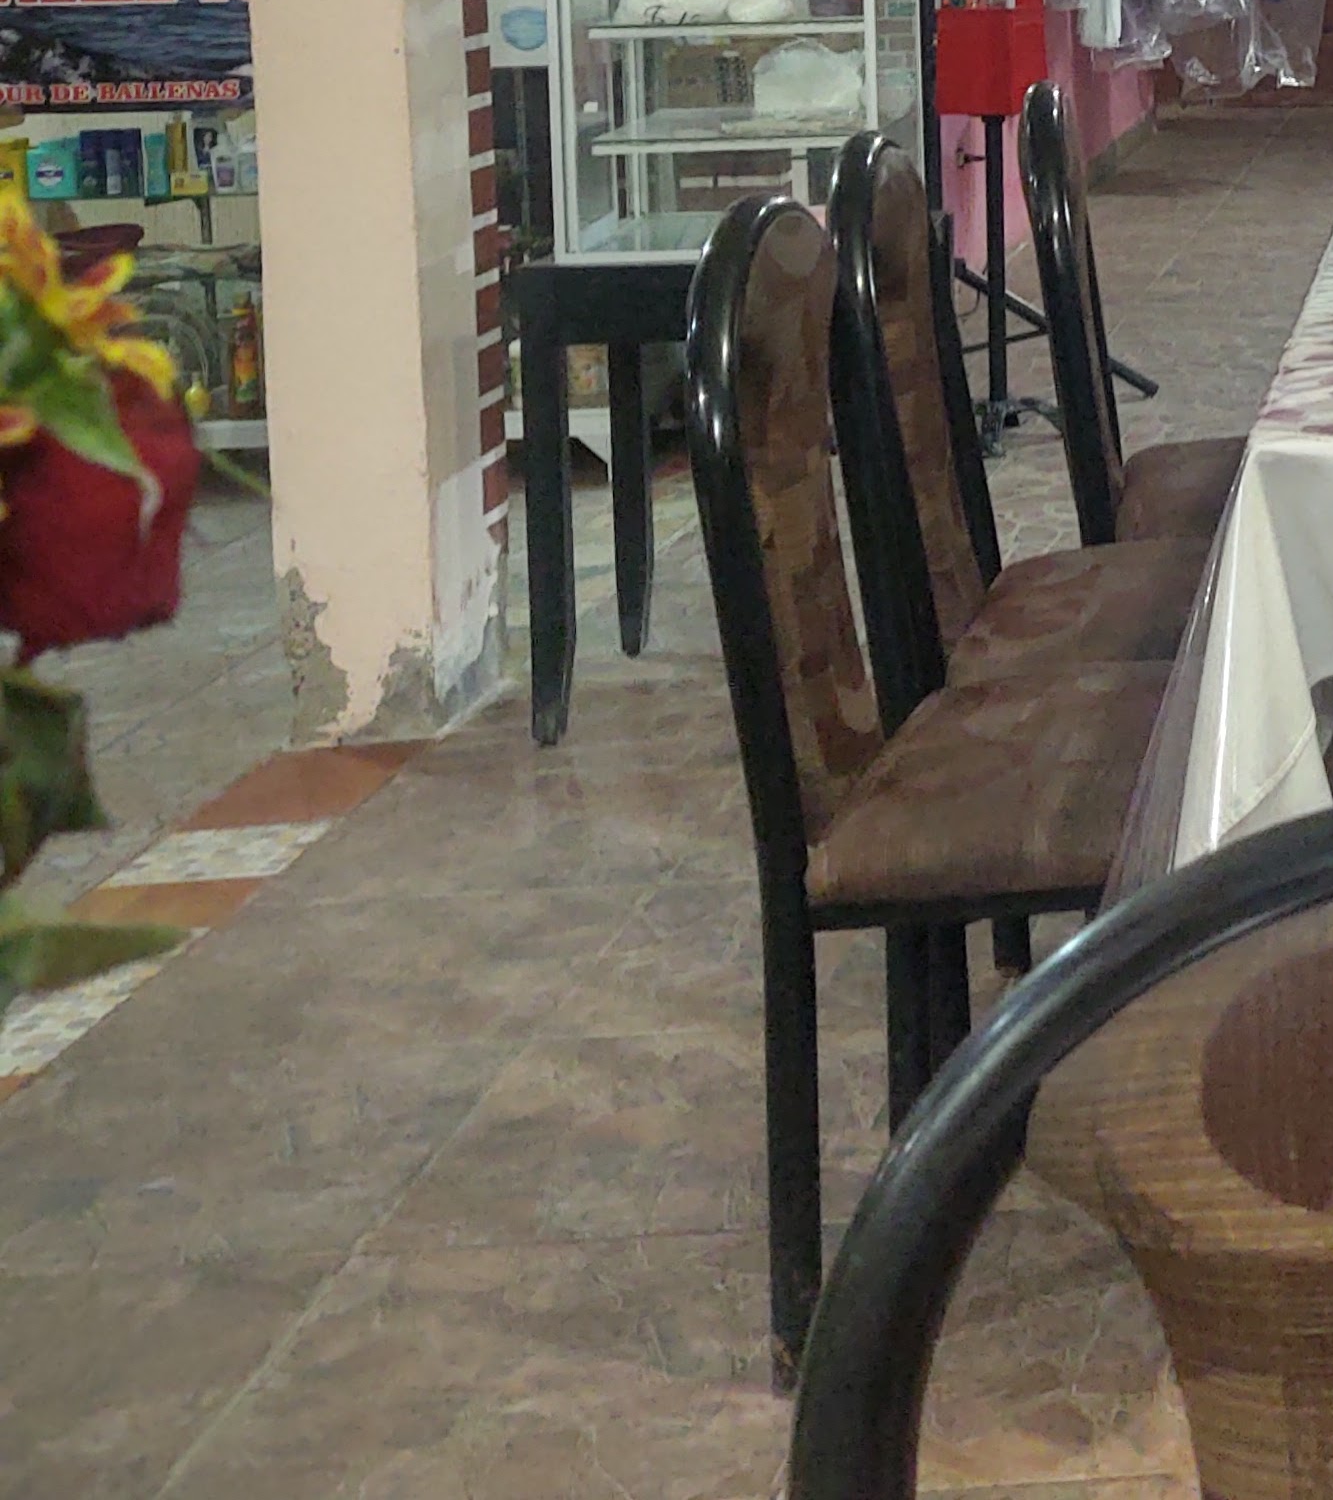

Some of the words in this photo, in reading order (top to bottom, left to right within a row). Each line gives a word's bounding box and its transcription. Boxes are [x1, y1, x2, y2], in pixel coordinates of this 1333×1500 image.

[0, 83, 44, 104] UR
[50, 82, 92, 104] DE
[97, 79, 240, 102] BALLENAS
